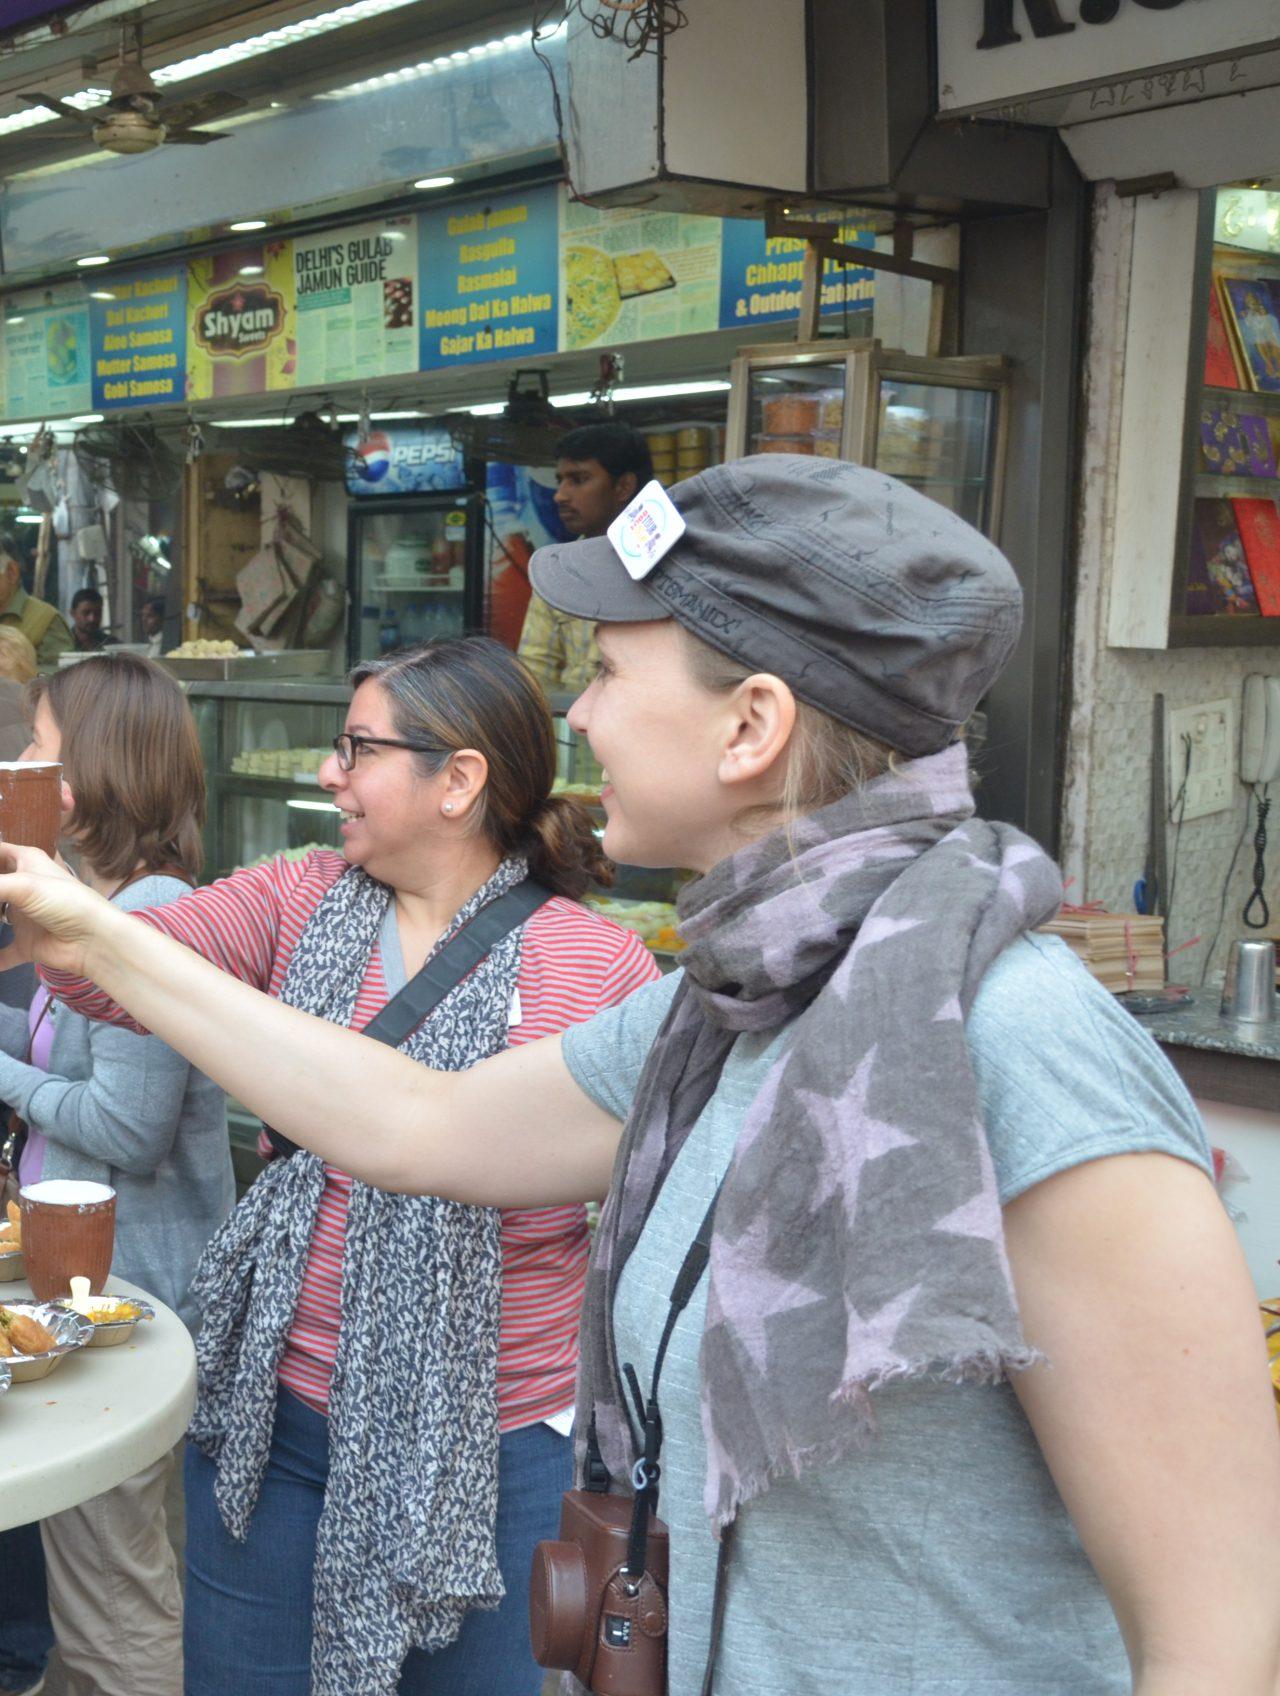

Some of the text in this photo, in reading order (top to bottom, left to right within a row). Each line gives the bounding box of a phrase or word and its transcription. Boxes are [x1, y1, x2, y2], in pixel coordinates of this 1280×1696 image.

[296, 236, 394, 273] DELHI'S GULAB
[459, 236, 516, 265] Rasgulla
[297, 259, 387, 295] JAMUN GUIDE
[457, 265, 518, 294] Rasmalai
[425, 293, 551, 328] Moong Dal Ka Halwa
[735, 297, 748, 318] &
[203, 307, 275, 338] Shyam
[129, 328, 173, 347] Samosa
[440, 326, 535, 356] Gajar Ka Halwa
[133, 353, 177, 373] Samosa
[129, 378, 173, 397] Samosa
[393, 441, 456, 467] PEPSI
